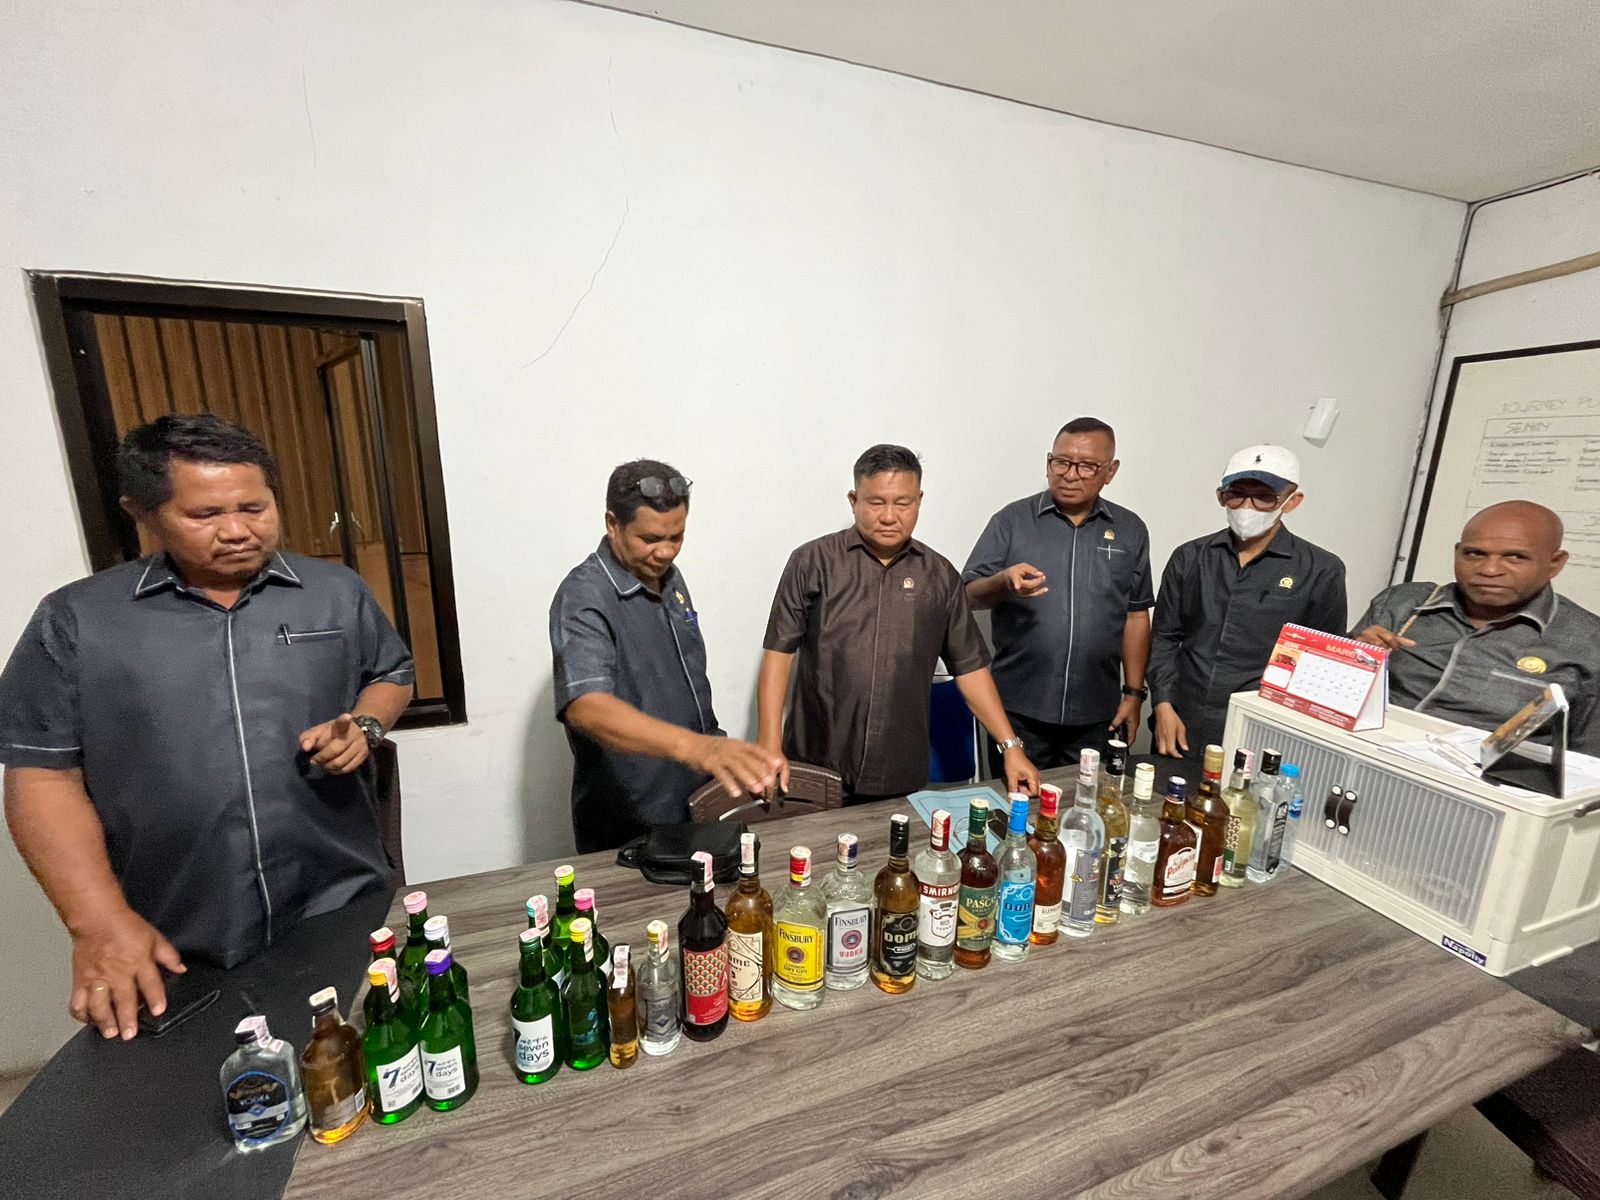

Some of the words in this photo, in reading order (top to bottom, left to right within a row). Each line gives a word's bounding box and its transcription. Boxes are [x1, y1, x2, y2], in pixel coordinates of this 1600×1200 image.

[779, 928, 814, 943] FINSBURY
[519, 1041, 549, 1051] seven
[519, 1049, 550, 1063] days
